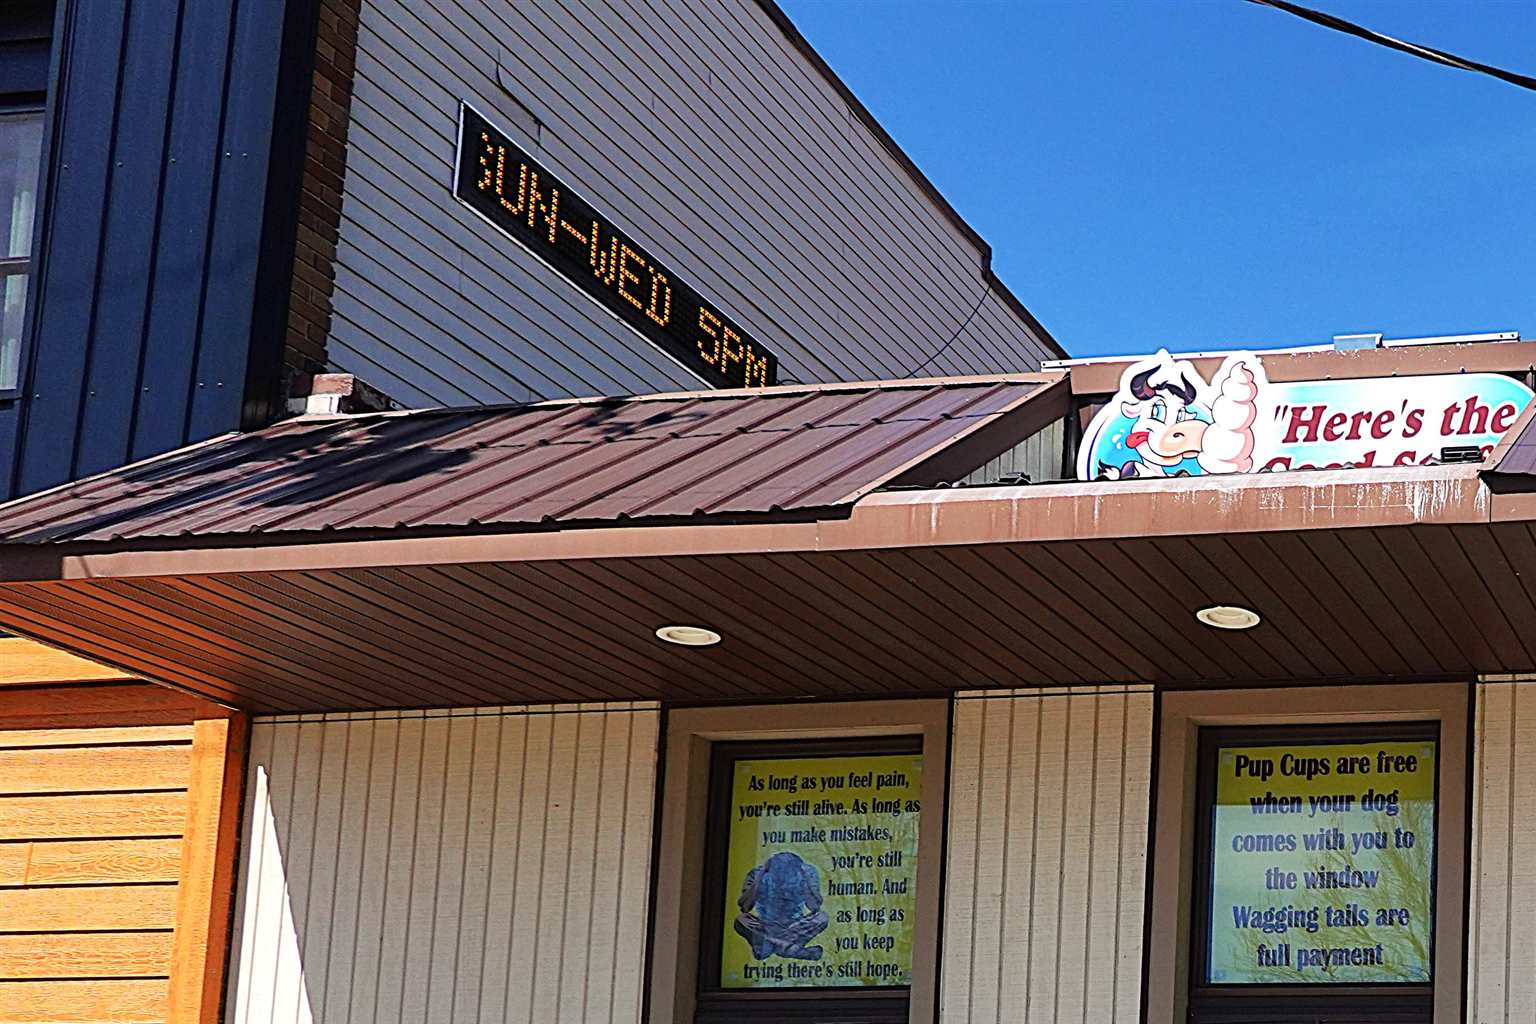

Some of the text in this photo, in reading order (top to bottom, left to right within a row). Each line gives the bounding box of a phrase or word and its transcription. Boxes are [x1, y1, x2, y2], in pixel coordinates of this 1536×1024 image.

[697, 306, 766, 388] 5PM
[1440, 396, 1516, 436] the
[1235, 751, 1417, 781] Pup Cups are free
[748, 771, 909, 793] As long as you feel pain,
[739, 798, 920, 821] you're still alive. As long as
[1250, 789, 1399, 817] when your dog
[763, 831, 786, 846] you
[791, 827, 826, 843] make
[1232, 827, 1415, 855] comes with you to
[832, 851, 902, 871] you're still
[828, 878, 907, 895] human. And
[1265, 865, 1379, 889] the window
[837, 906, 904, 925] as long as
[1232, 904, 1410, 933] Wagging tails are
[835, 934, 894, 953] you keep
[1258, 944, 1383, 971] full payment
[743, 960, 903, 982] trying there's still hope.
